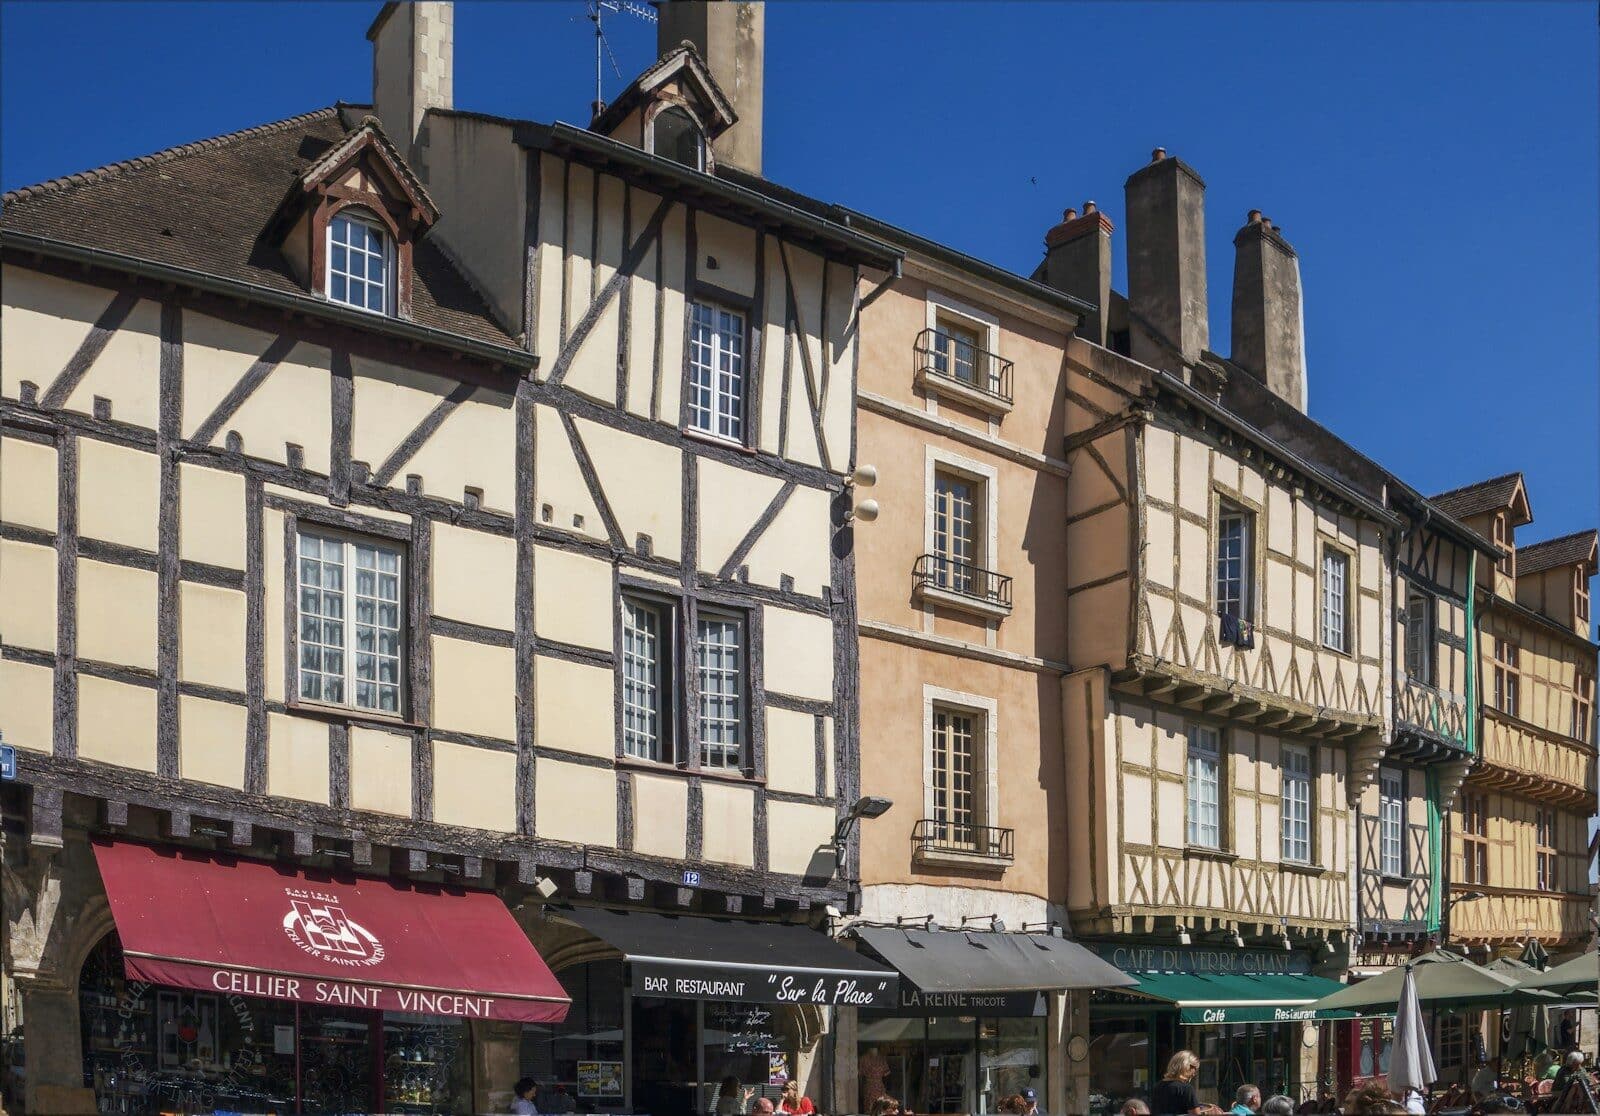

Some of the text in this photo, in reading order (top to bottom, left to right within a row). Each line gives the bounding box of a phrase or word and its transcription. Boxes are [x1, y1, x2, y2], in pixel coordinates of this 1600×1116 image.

[687, 873, 697, 884] 12
[284, 928, 321, 957] CELLIER
[1163, 950, 1183, 970] DU
[212, 970, 494, 1017] CELLIER SAINT VINCENT
[644, 976, 668, 992] BAR
[675, 979, 745, 997] RESTAURANT
[811, 978, 826, 1003] la
[902, 990, 920, 1007] LA
[925, 991, 968, 1007] REINE
[1203, 1008, 1318, 1022] Café Restaurant
